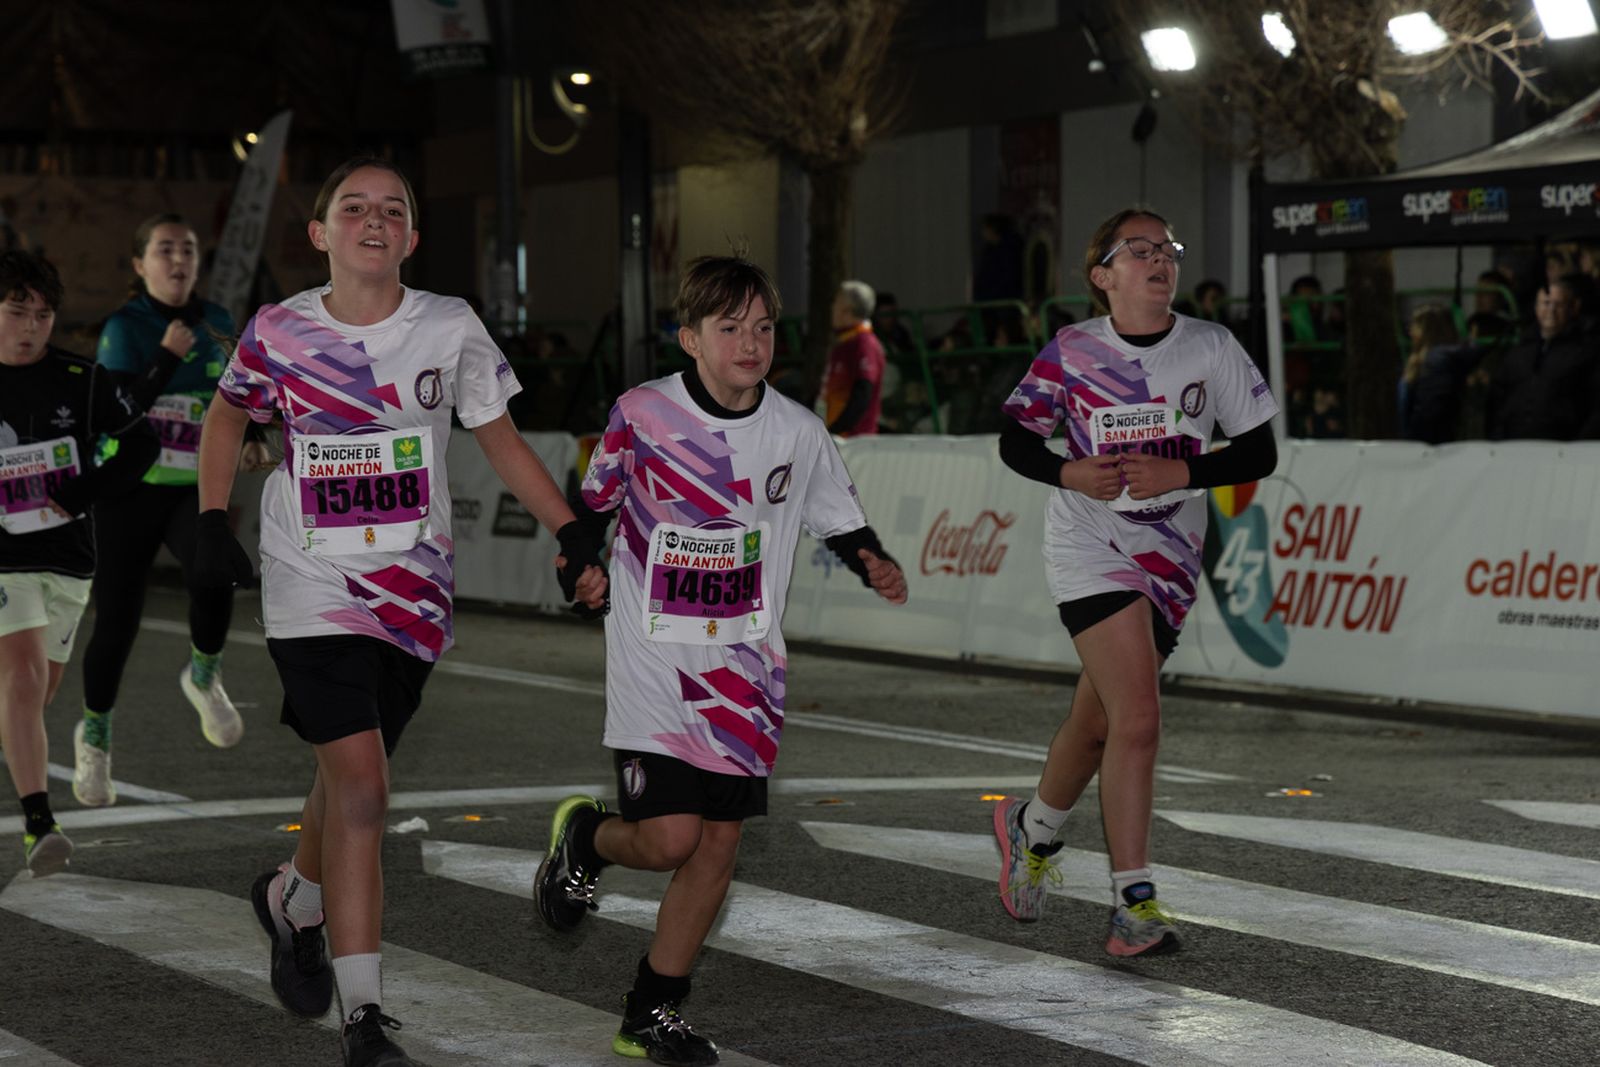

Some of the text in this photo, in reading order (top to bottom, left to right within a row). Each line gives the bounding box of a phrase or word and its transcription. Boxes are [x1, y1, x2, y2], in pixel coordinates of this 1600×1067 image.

[1116, 416, 1152, 428] NOCHE
[1153, 413, 1166, 424] DE
[1105, 424, 1167, 442] SAN ANTÓN
[322, 447, 381, 461] NOCHE DE
[309, 460, 382, 477] SAN ANTÓN
[310, 472, 420, 514] 15488
[1274, 503, 1361, 562] SAN
[680, 541, 735, 554] NOCHE DE
[663, 552, 690, 566] SAN
[692, 554, 735, 569] ANTÓN
[1213, 527, 1266, 616] 43
[663, 567, 755, 606] 14639
[1465, 550, 1600, 602] calder
[1262, 555, 1408, 633] ANTÓN
[1498, 608, 1600, 631] obras maestras
